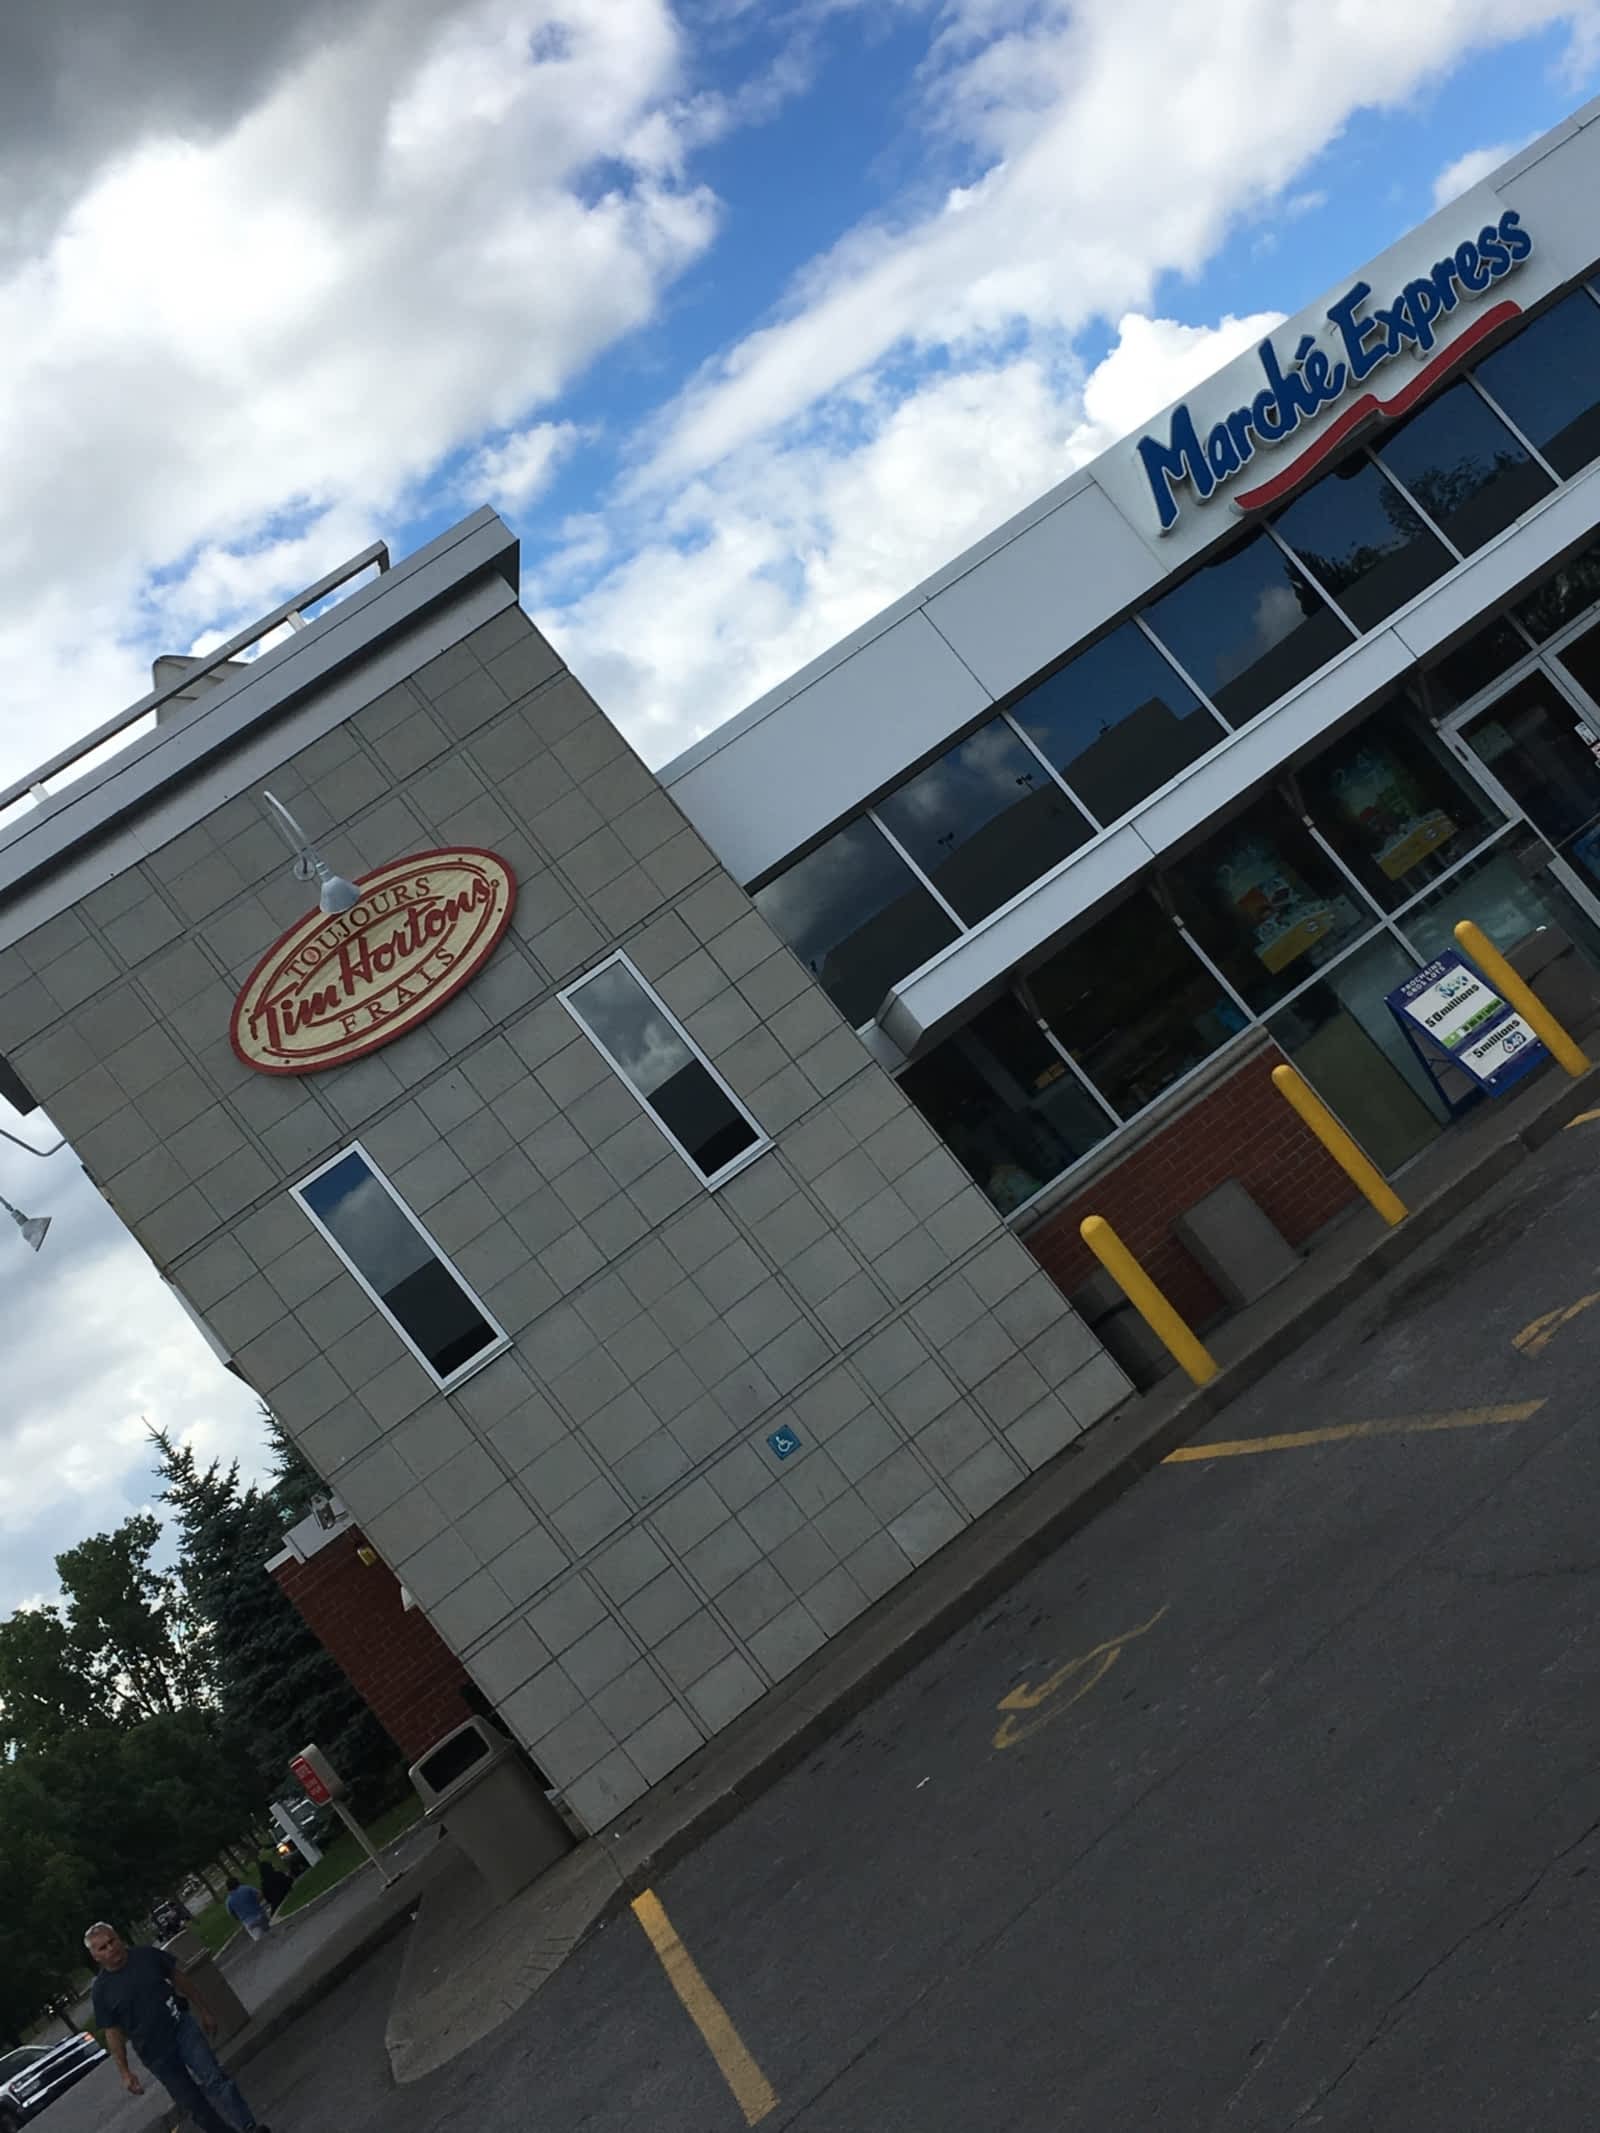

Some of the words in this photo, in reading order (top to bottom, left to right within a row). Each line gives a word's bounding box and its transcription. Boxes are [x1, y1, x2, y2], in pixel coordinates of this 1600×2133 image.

[1137, 335, 1345, 530] Marché
[1327, 210, 1532, 381] Express
[247, 982, 341, 1049] Tim
[335, 878, 490, 996] Hortons
[284, 876, 431, 980] TOUJOURS
[339, 948, 455, 1036] FRAIS
[1400, 961, 1441, 992] PROCHAINS
[1406, 979, 1428, 997] GROS
[1427, 966, 1446, 982] LOTS
